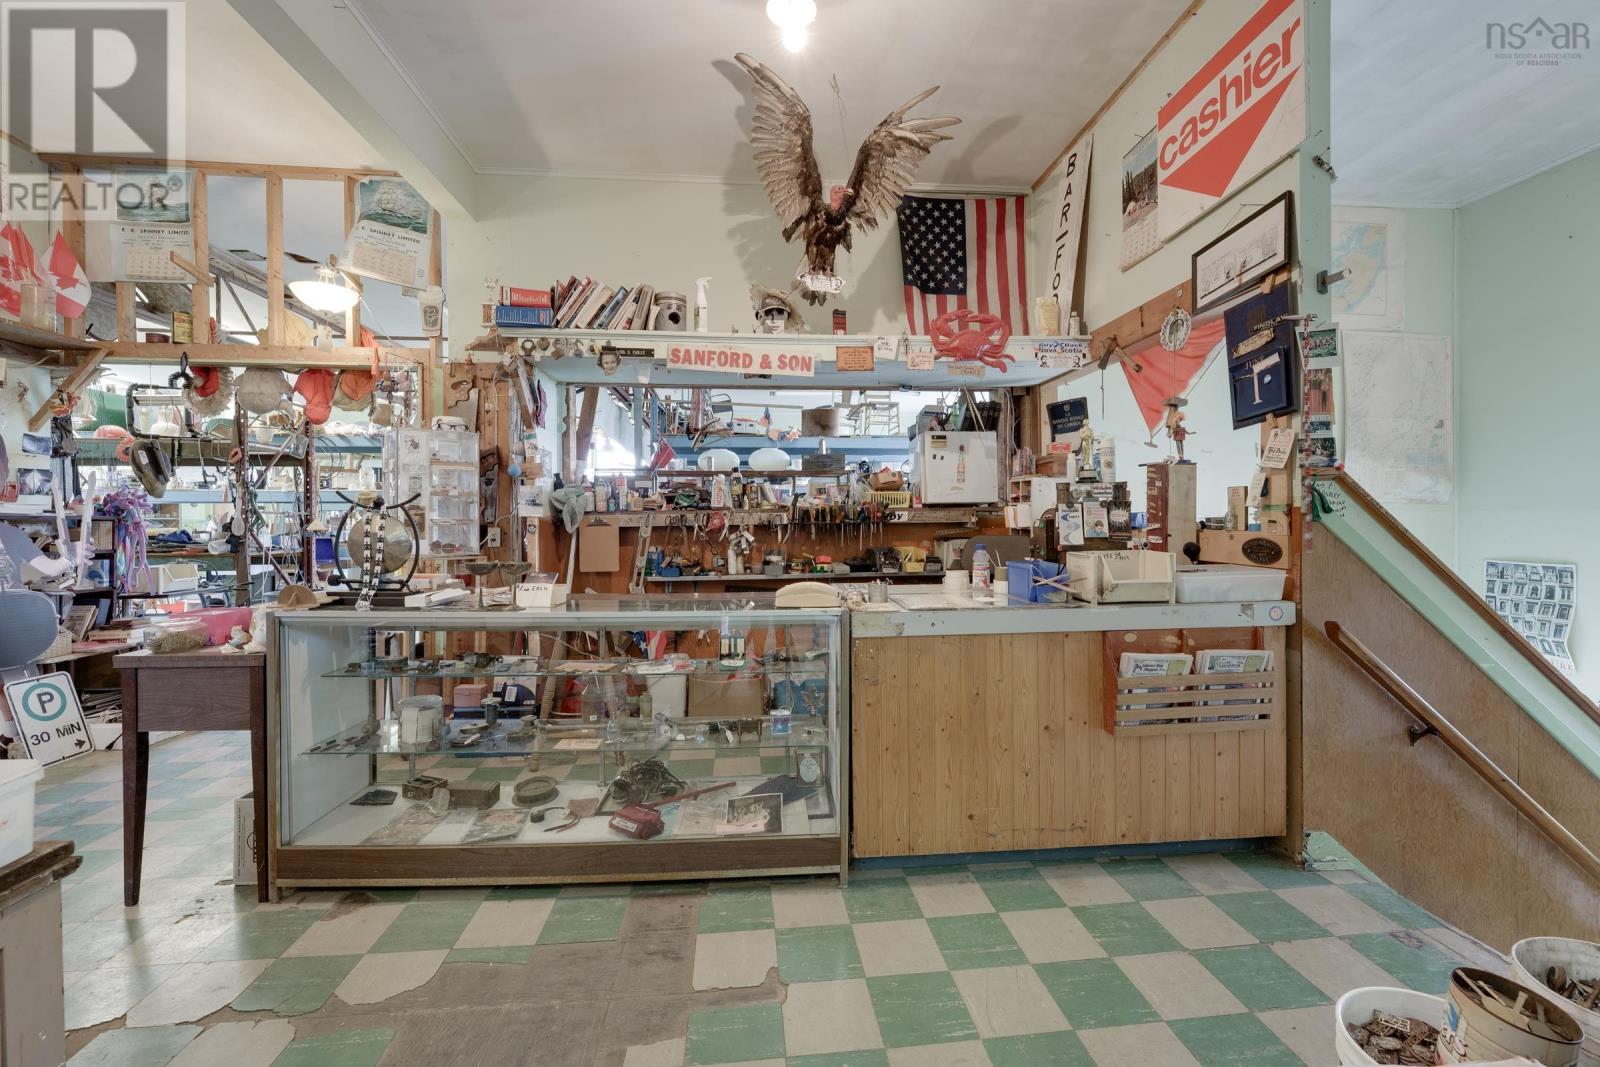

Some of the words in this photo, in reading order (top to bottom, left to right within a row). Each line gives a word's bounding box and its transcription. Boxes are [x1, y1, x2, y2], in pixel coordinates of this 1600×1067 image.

[1159, 17, 1301, 170] cashier
[670, 347, 753, 369] SANFORD
[759, 353, 772, 370] &
[777, 354, 812, 372] SON
[36, 691, 55, 714] P
[30, 731, 51, 746] 30
